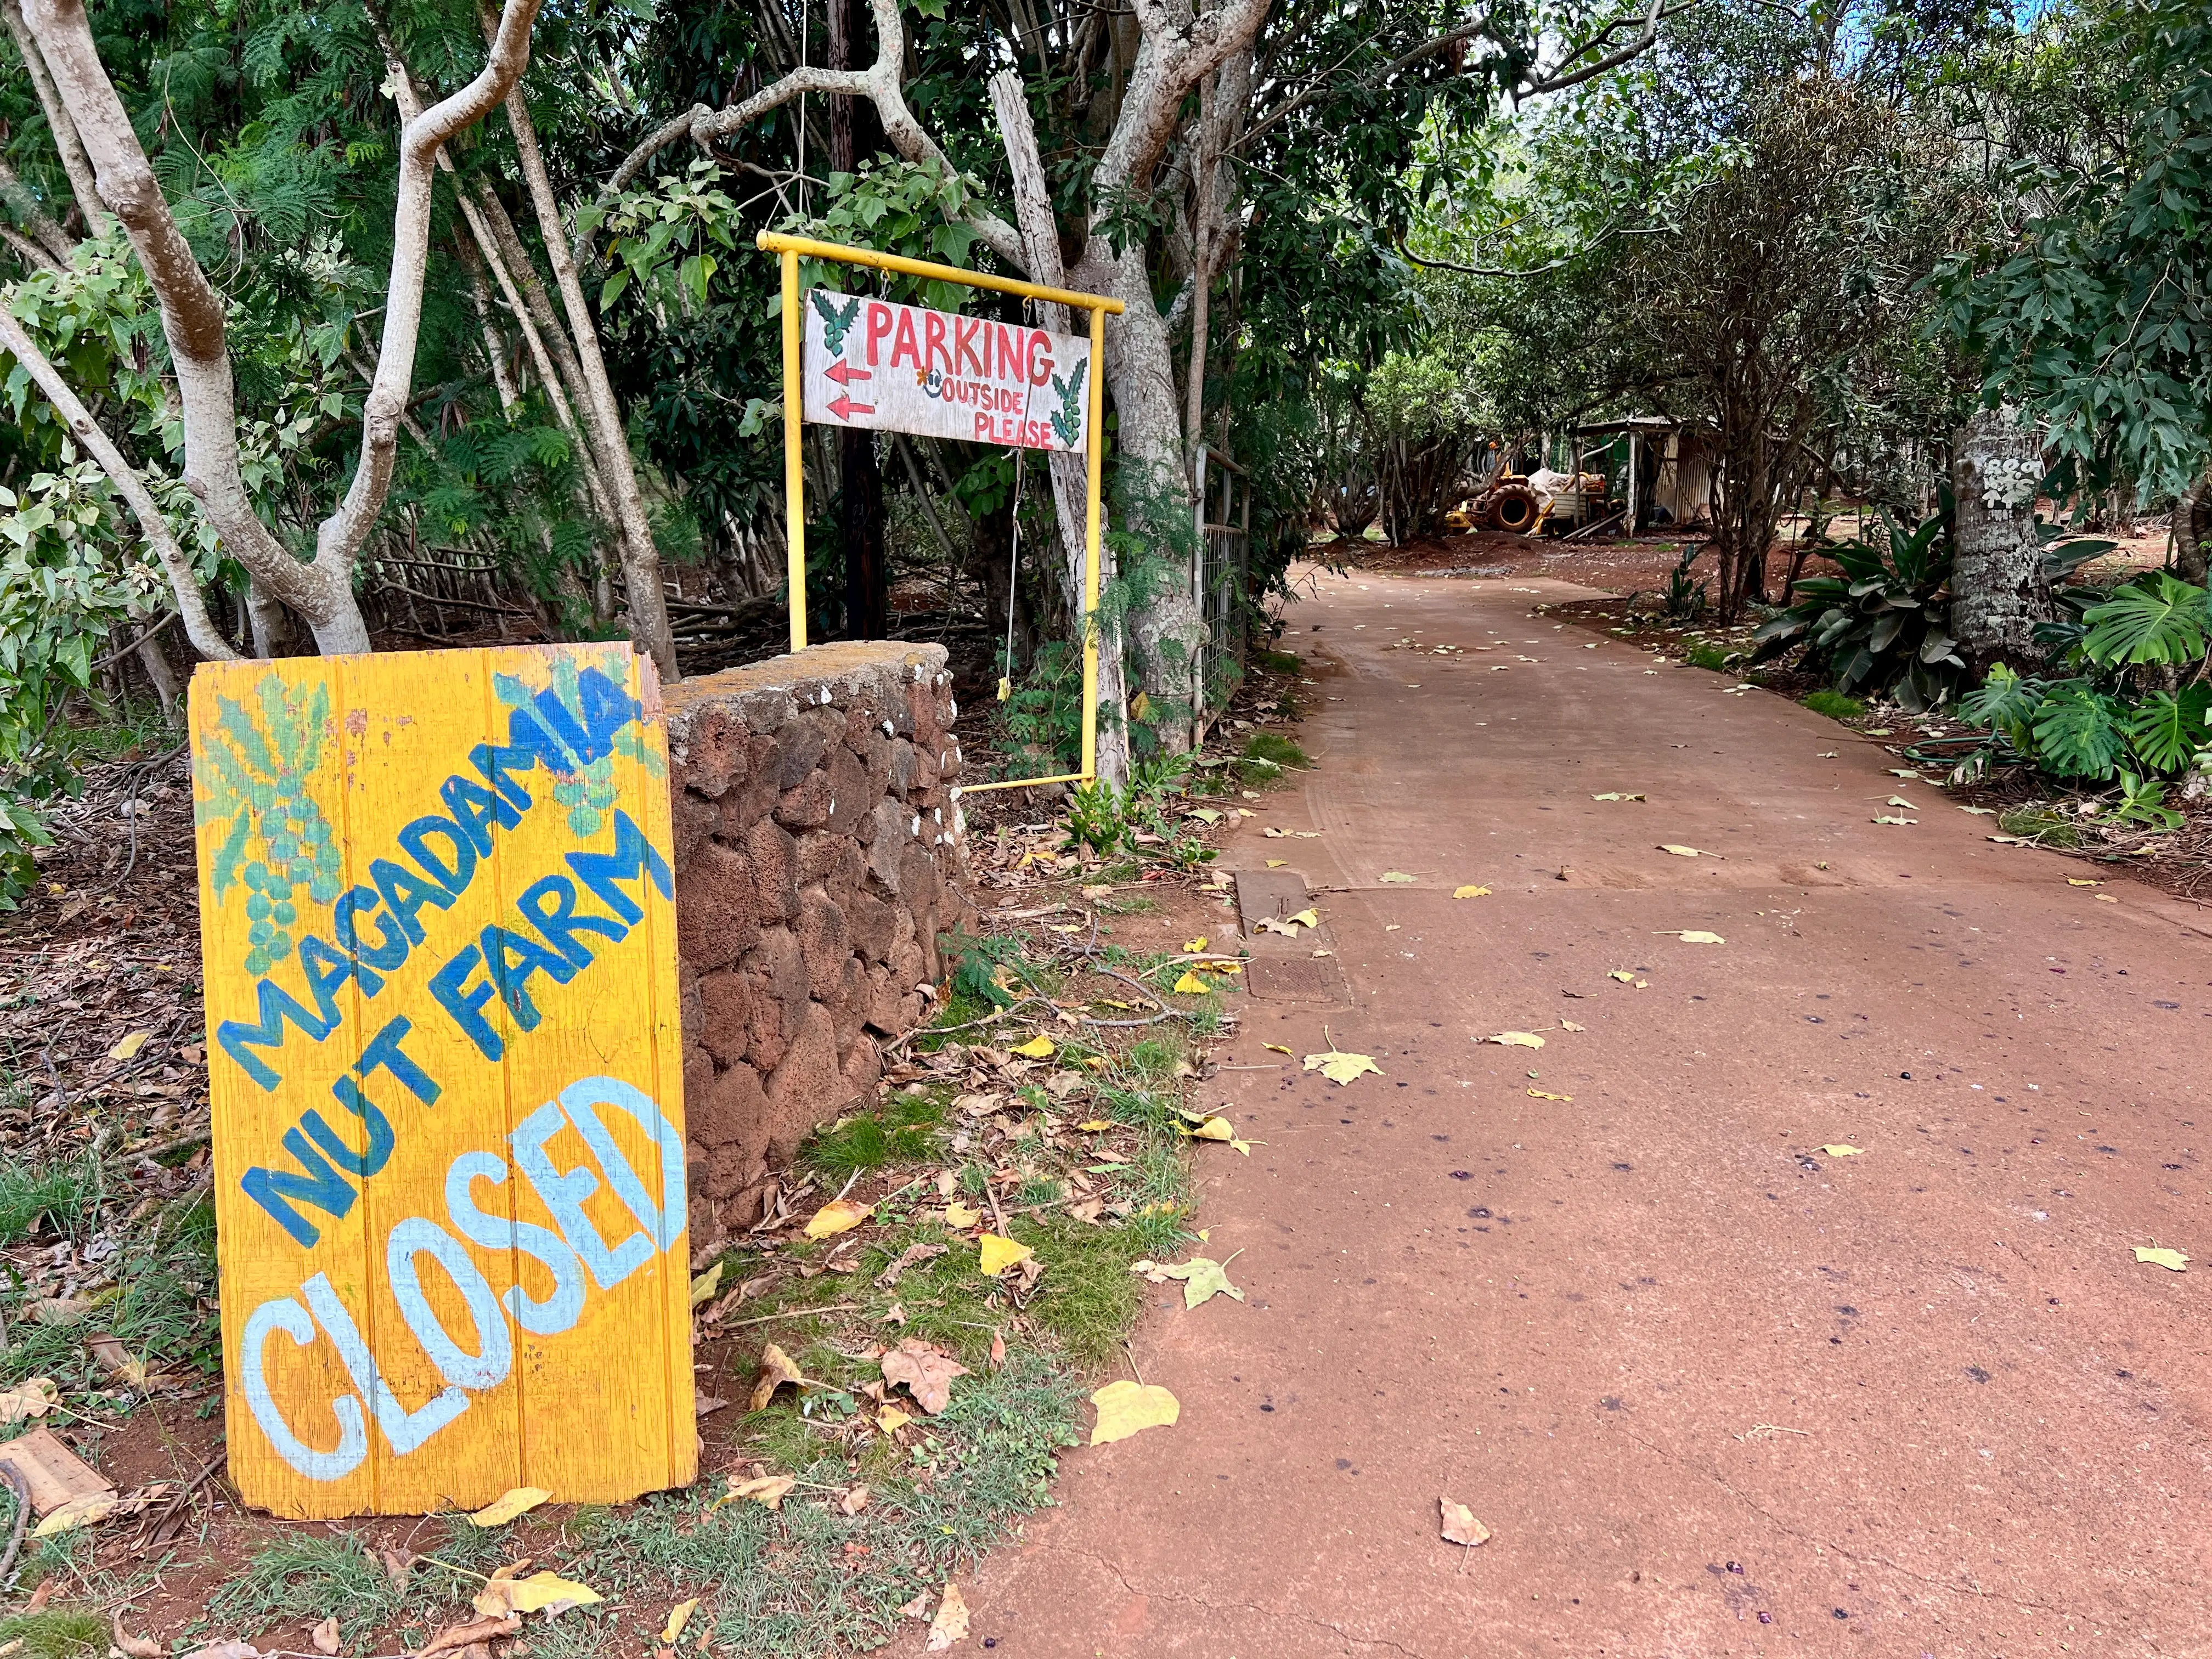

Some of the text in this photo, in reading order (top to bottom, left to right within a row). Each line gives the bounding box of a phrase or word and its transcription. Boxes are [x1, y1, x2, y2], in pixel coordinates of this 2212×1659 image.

[867, 303, 1054, 387] PARKING
[941, 377, 1024, 415] OUTSIDE
[975, 413, 1054, 450] PLEASE
[217, 666, 643, 1092] MACADAMIA
[241, 809, 673, 1249] NUT FARM
[241, 1075, 688, 1481] CLOSED
